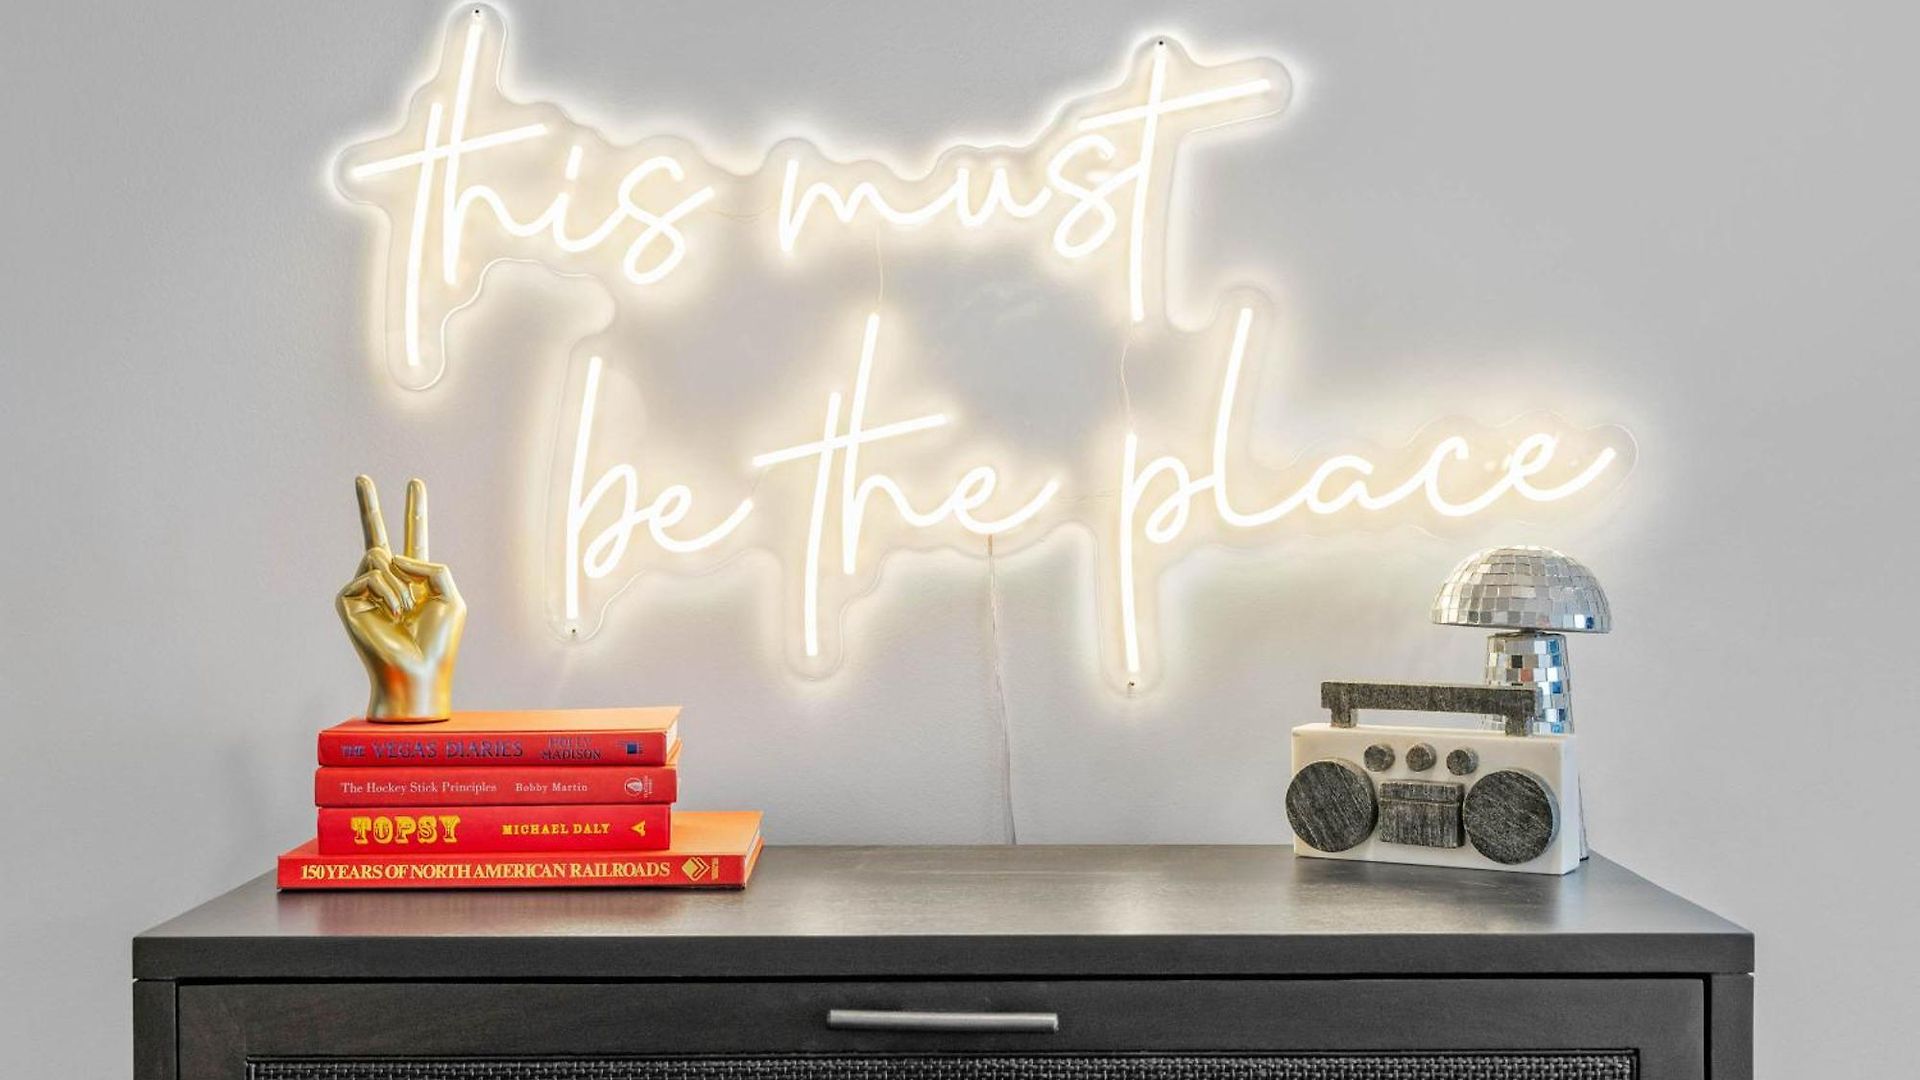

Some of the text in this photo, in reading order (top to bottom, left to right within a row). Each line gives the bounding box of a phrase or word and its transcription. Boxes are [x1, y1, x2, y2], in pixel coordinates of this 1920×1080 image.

[351, 20, 1272, 368] this must
[565, 306, 1617, 673] be the place
[341, 740, 524, 759] THE VEGAS DIARIES
[341, 782, 497, 797] The Hockey Stick Principles
[515, 782, 588, 793] Bobby Martin
[351, 815, 461, 845] TOPSY
[502, 822, 610, 835] MICHAEL DALY
[300, 861, 670, 880] 150 YEARS OF NORTH AMERICAN RAILROADS
